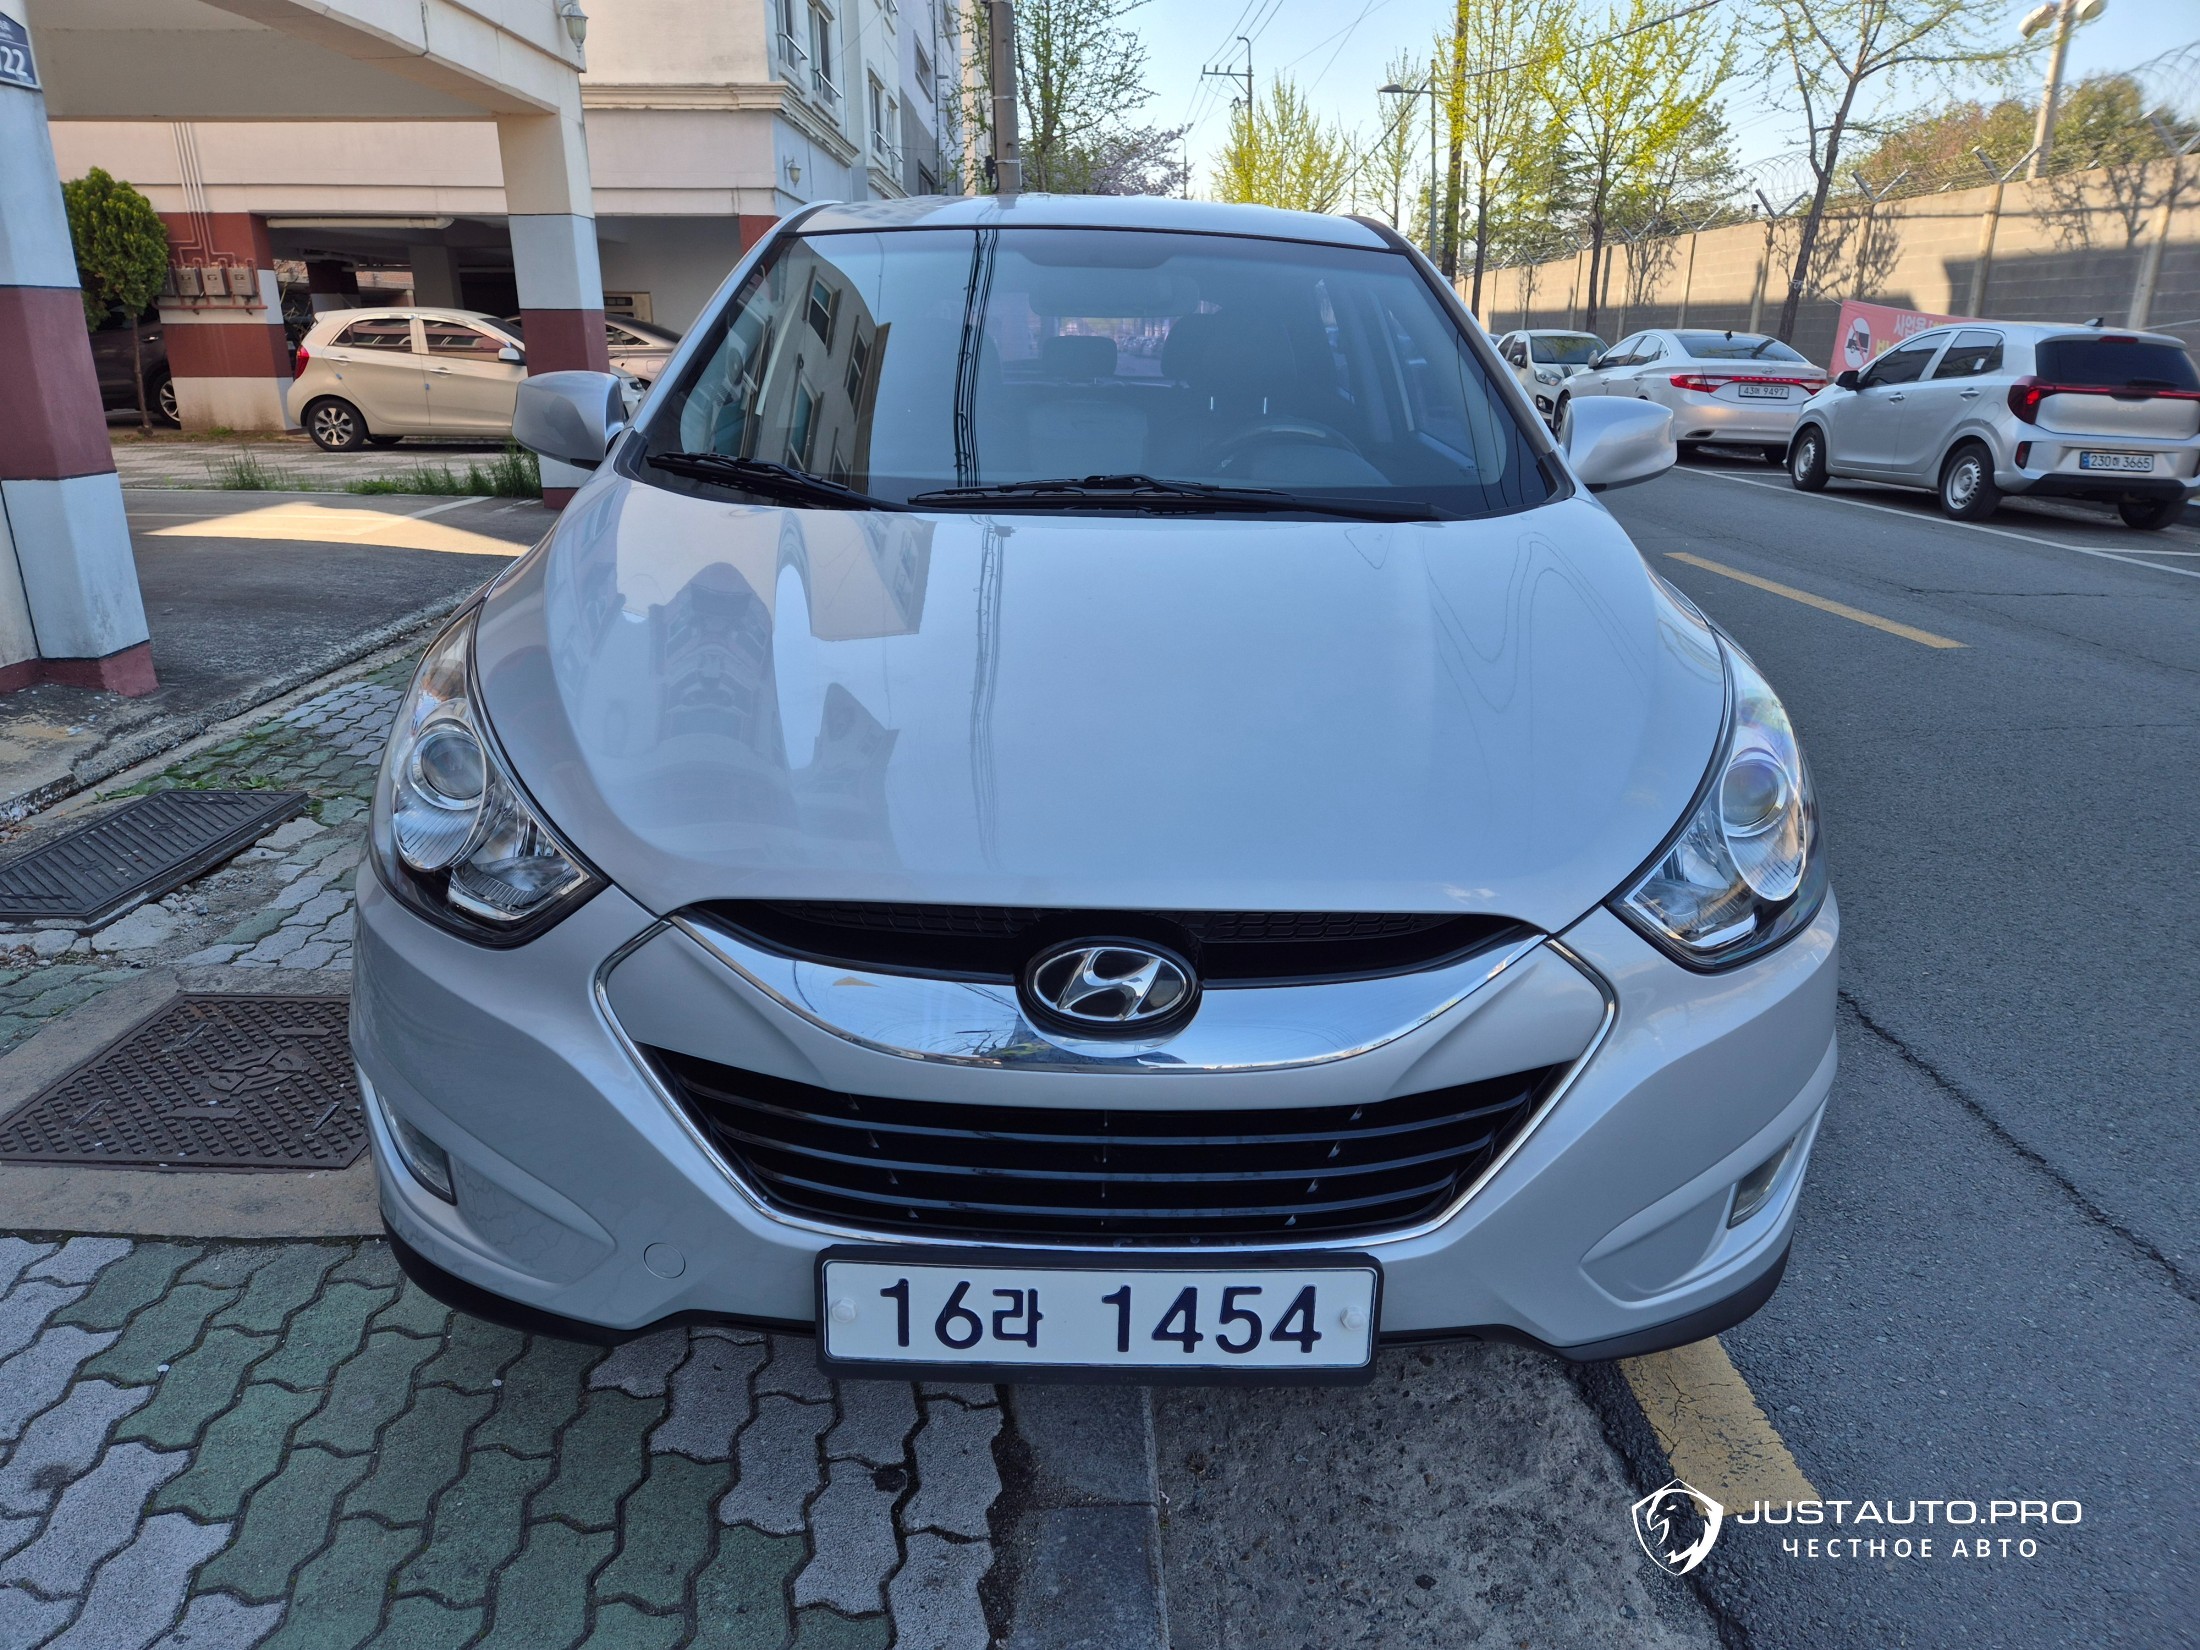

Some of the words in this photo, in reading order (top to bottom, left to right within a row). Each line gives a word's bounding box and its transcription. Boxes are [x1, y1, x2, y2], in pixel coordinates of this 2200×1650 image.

[0, 45, 28, 77] 22
[1763, 387, 1785, 396] 9497
[2122, 456, 2151, 469] 3665
[880, 1277, 1045, 1350] 16라
[1101, 1284, 1323, 1355] 1454
